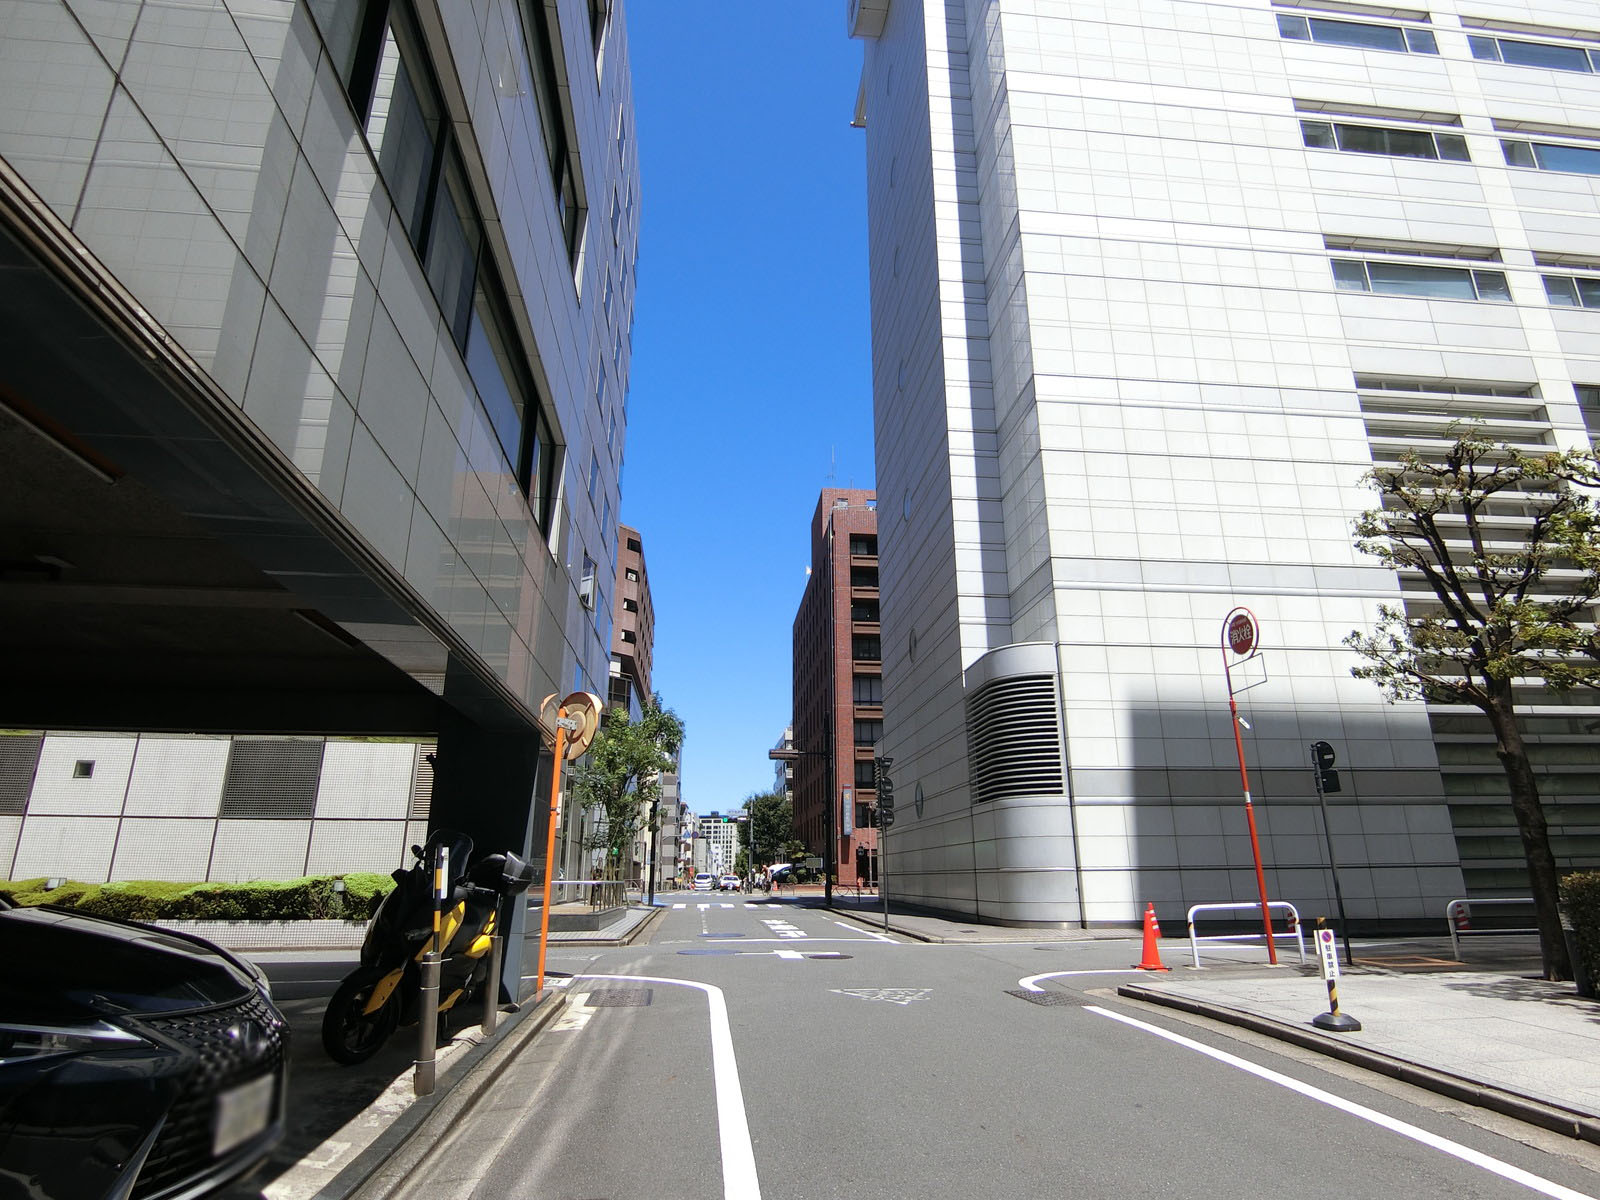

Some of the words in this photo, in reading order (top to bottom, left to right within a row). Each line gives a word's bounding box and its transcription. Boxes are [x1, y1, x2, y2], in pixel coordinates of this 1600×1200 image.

[1230, 624, 1252, 645] 消火栓
[1325, 944, 1336, 977] 駐車禁止
